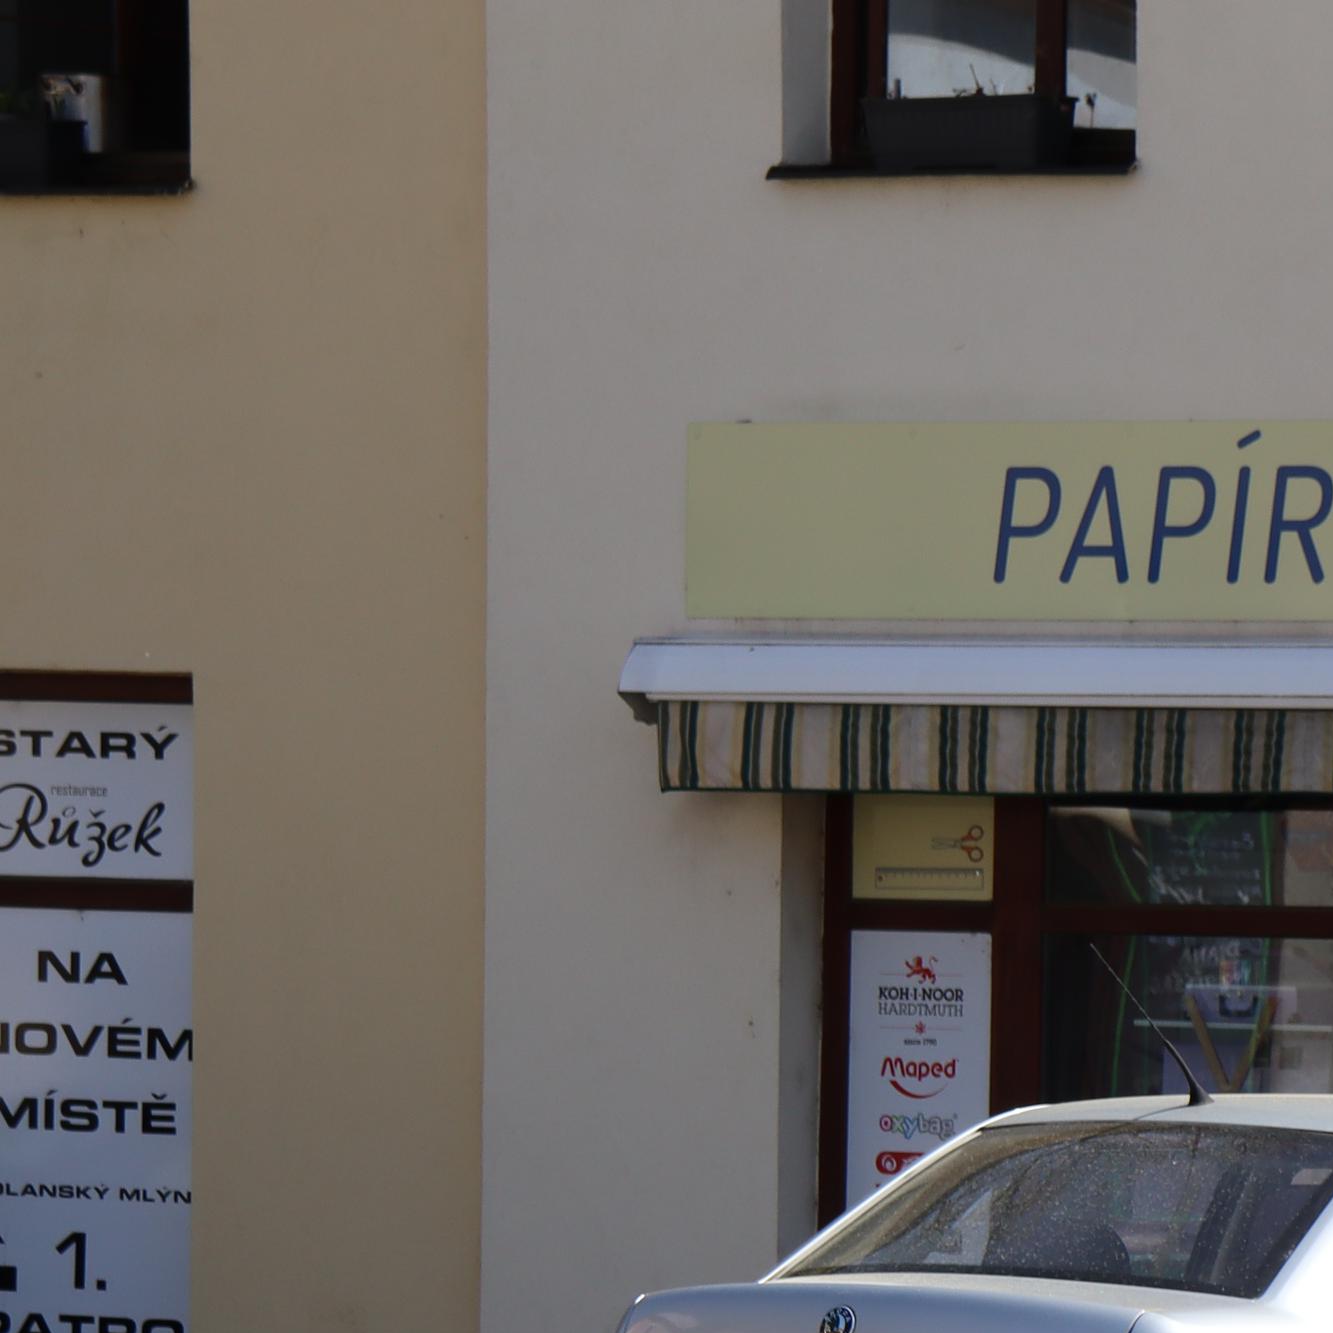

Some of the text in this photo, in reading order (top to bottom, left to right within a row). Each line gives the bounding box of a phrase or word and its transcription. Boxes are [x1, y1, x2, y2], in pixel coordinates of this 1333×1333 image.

[0, 725, 179, 760] STARÝ
[51, 785, 108, 797] restaurace
[0, 783, 165, 867] Růžek
[38, 950, 128, 986] NA
[878, 1002, 964, 1017] HARDTMUTH
[880, 1056, 957, 1081] Maped
[0, 1090, 177, 1135] MÍSTĚ
[880, 1113, 957, 1141] oxybag
[119, 1186, 192, 1204] MLÝN
[56, 1231, 107, 1291] 1.
